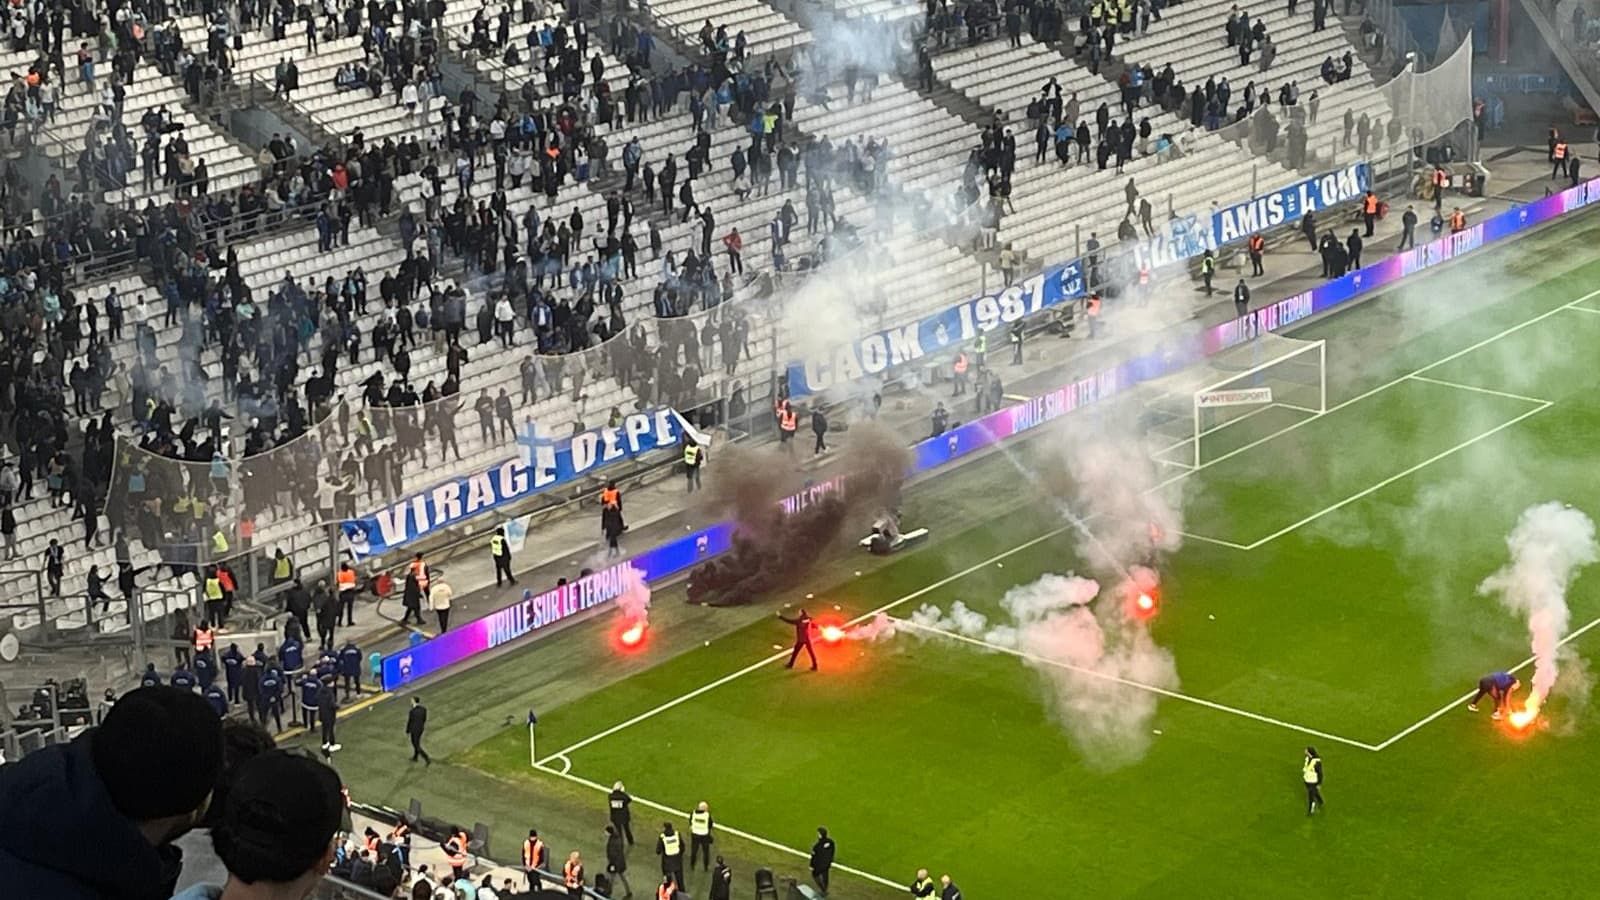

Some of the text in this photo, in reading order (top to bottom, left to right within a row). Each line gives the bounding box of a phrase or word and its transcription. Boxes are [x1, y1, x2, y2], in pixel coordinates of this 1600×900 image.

[1221, 192, 1285, 242] AMIS
[1299, 164, 1361, 215] L'OM
[804, 275, 1045, 392] CAOM 1987
[376, 408, 676, 547] VIRAGE DEPE
[487, 560, 633, 649] BRILLE SUR LE TERRAIN
